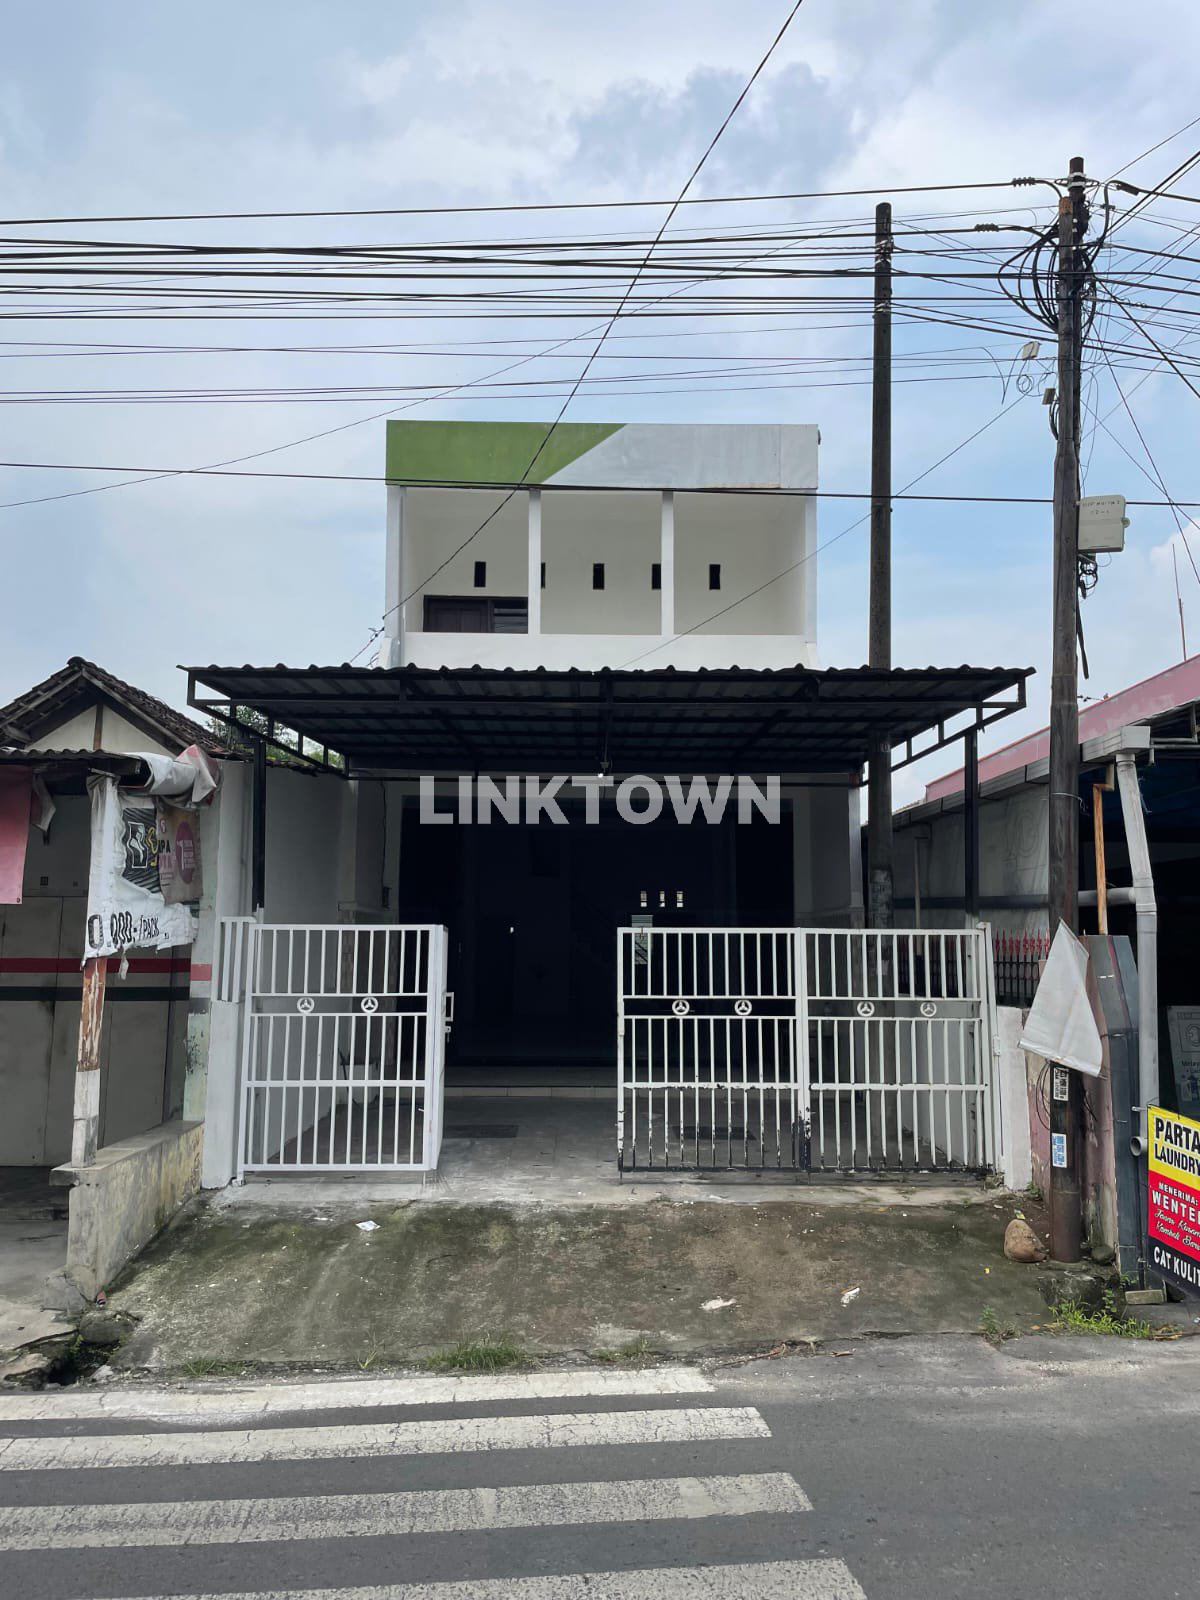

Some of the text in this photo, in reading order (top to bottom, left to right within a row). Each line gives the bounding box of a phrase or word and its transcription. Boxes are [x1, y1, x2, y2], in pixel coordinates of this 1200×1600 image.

[1155, 1117, 1200, 1154] PARTA
[1154, 1143, 1200, 1177] LAUNDRY
[1158, 1182, 1199, 1206] MENERIMA:
[1154, 1246, 1172, 1270] CAT
